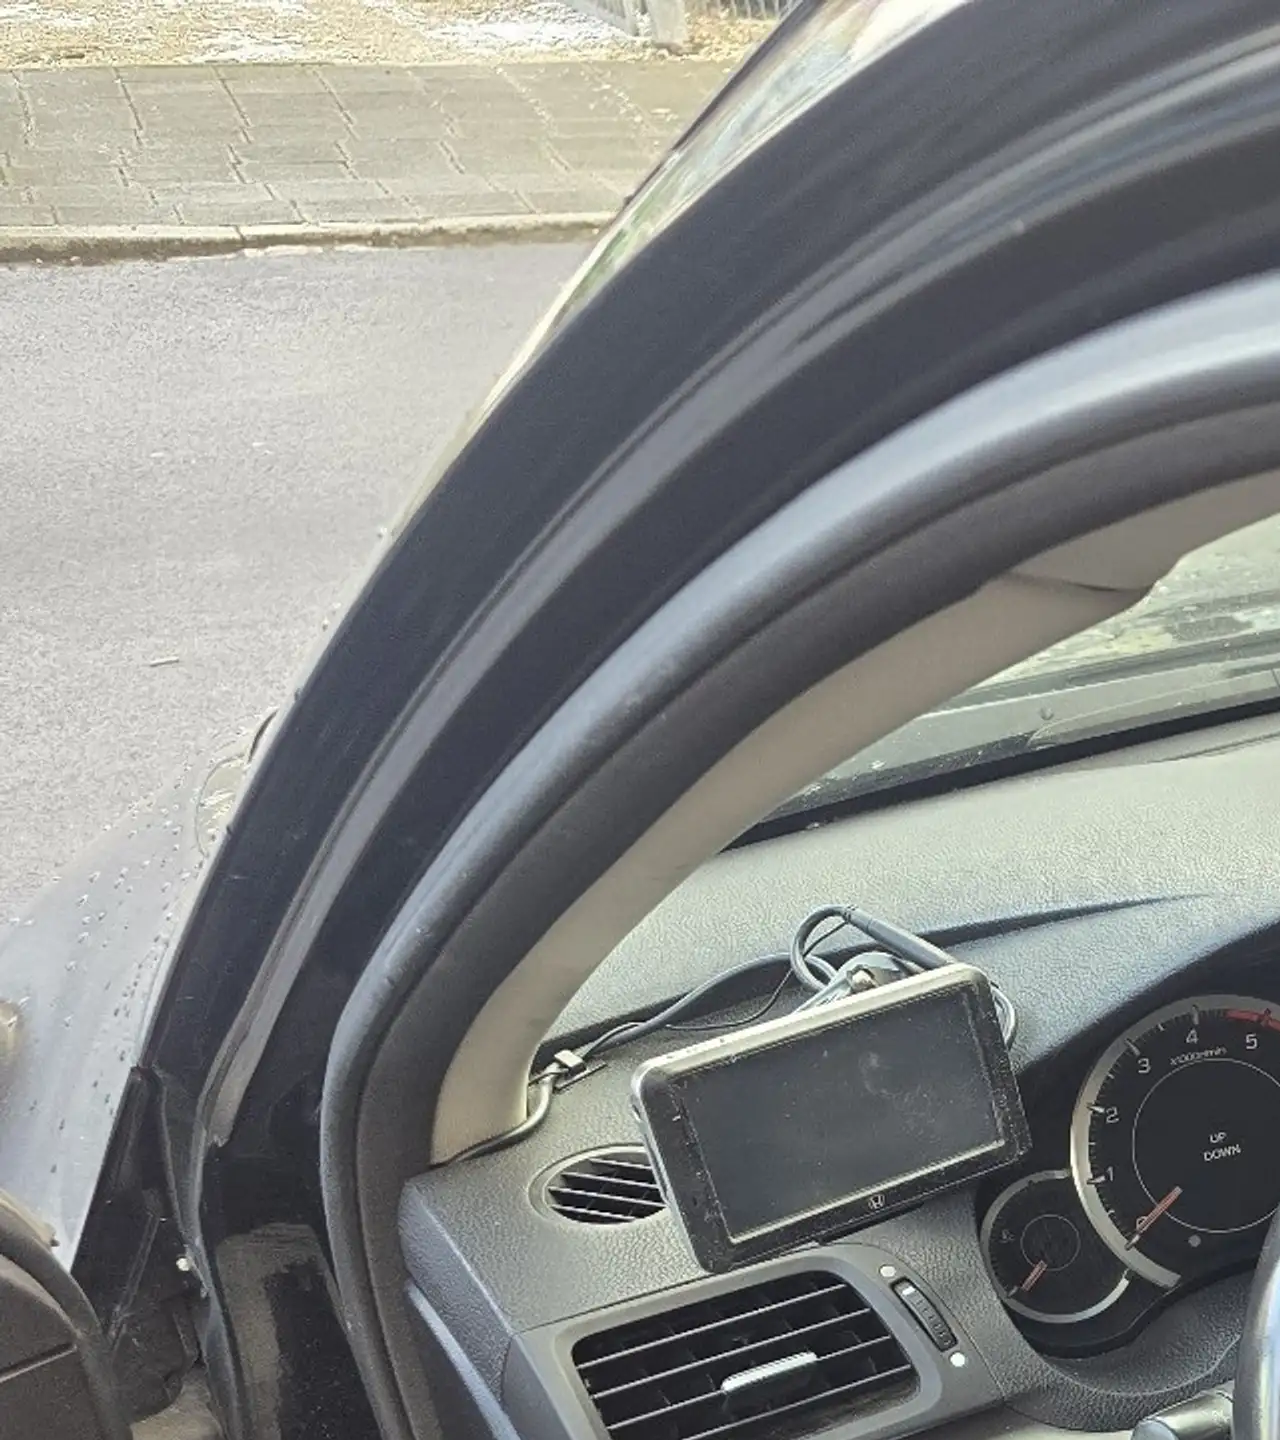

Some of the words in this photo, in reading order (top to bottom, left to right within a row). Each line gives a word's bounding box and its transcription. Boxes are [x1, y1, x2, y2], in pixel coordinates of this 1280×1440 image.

[1185, 1029, 1199, 1045] 4
[1245, 1033, 1258, 1050] 5
[1137, 1057, 1152, 1075] 3
[1105, 1105, 1120, 1124] 2
[1208, 1131, 1228, 1144] UP
[1203, 1143, 1242, 1162] DOWN
[1105, 1166, 1114, 1182] 1
